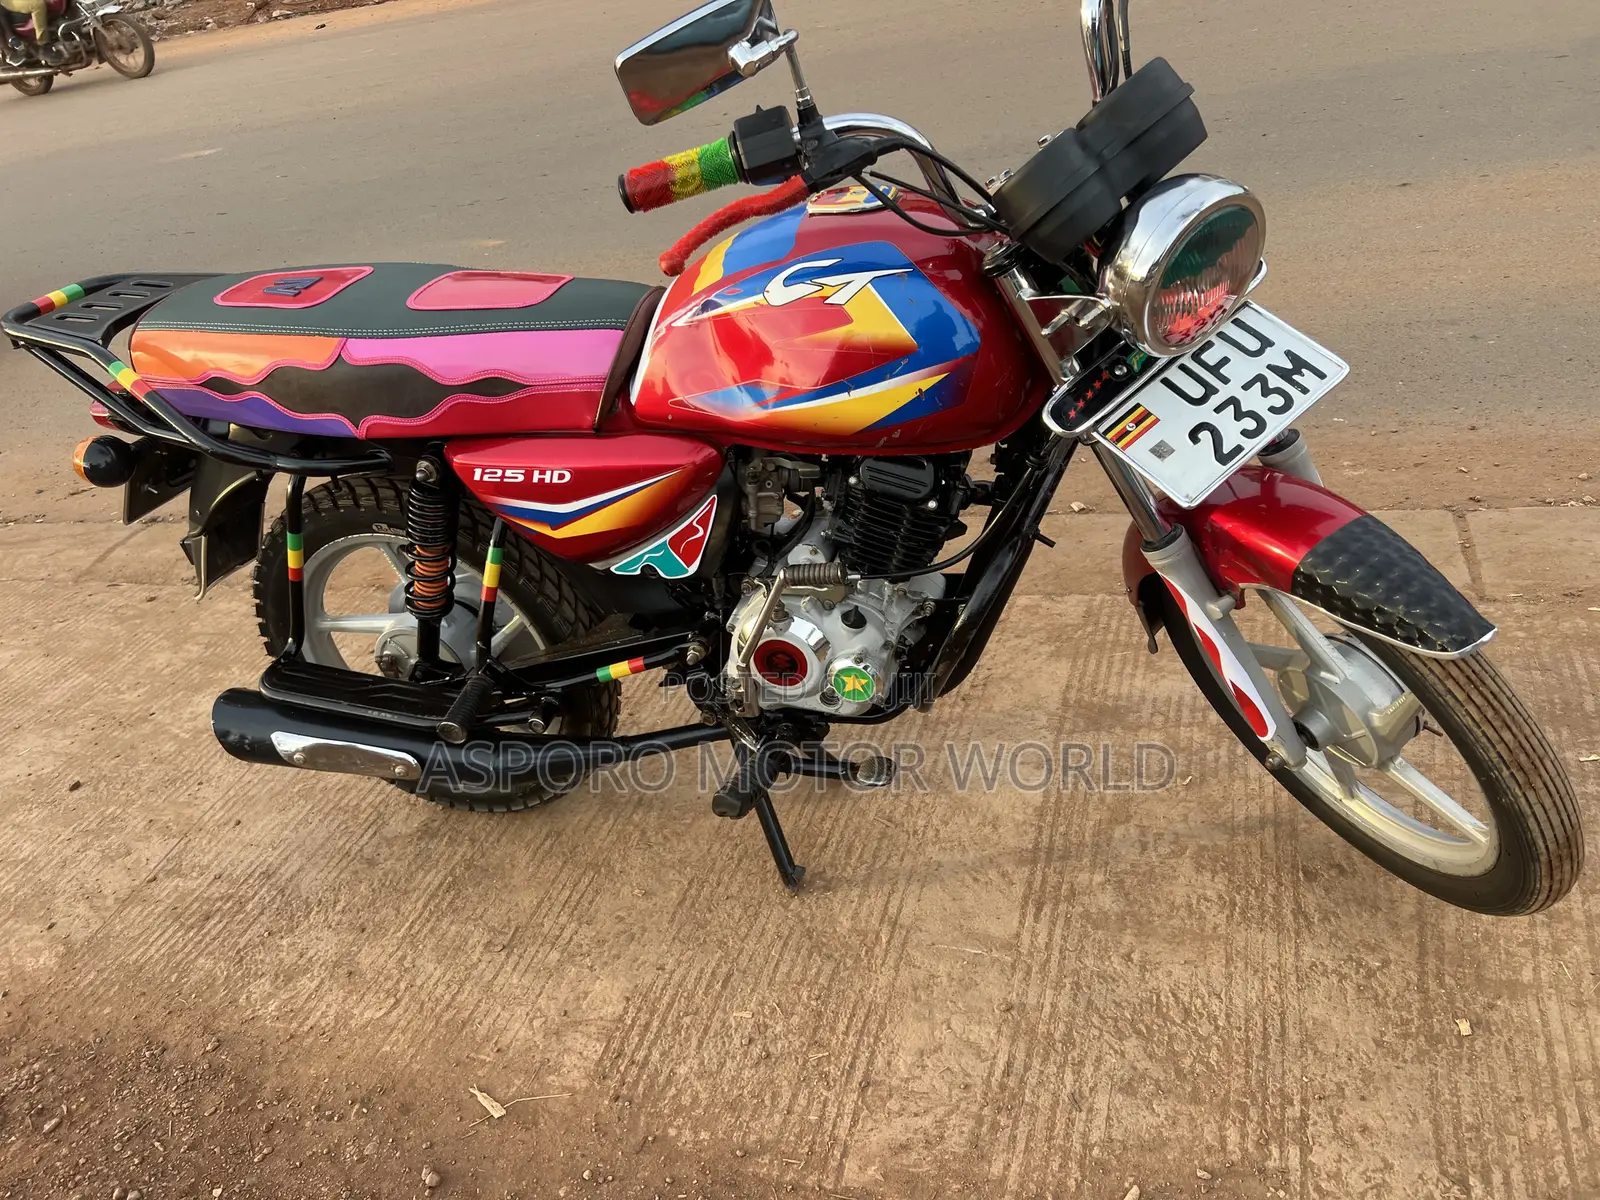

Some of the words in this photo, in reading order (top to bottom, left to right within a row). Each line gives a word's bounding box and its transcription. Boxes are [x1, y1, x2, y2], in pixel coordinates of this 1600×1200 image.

[1159, 317, 1276, 407] UFU
[1187, 349, 1328, 467] 233M
[472, 467, 526, 483] 125
[532, 469, 572, 484] HD
